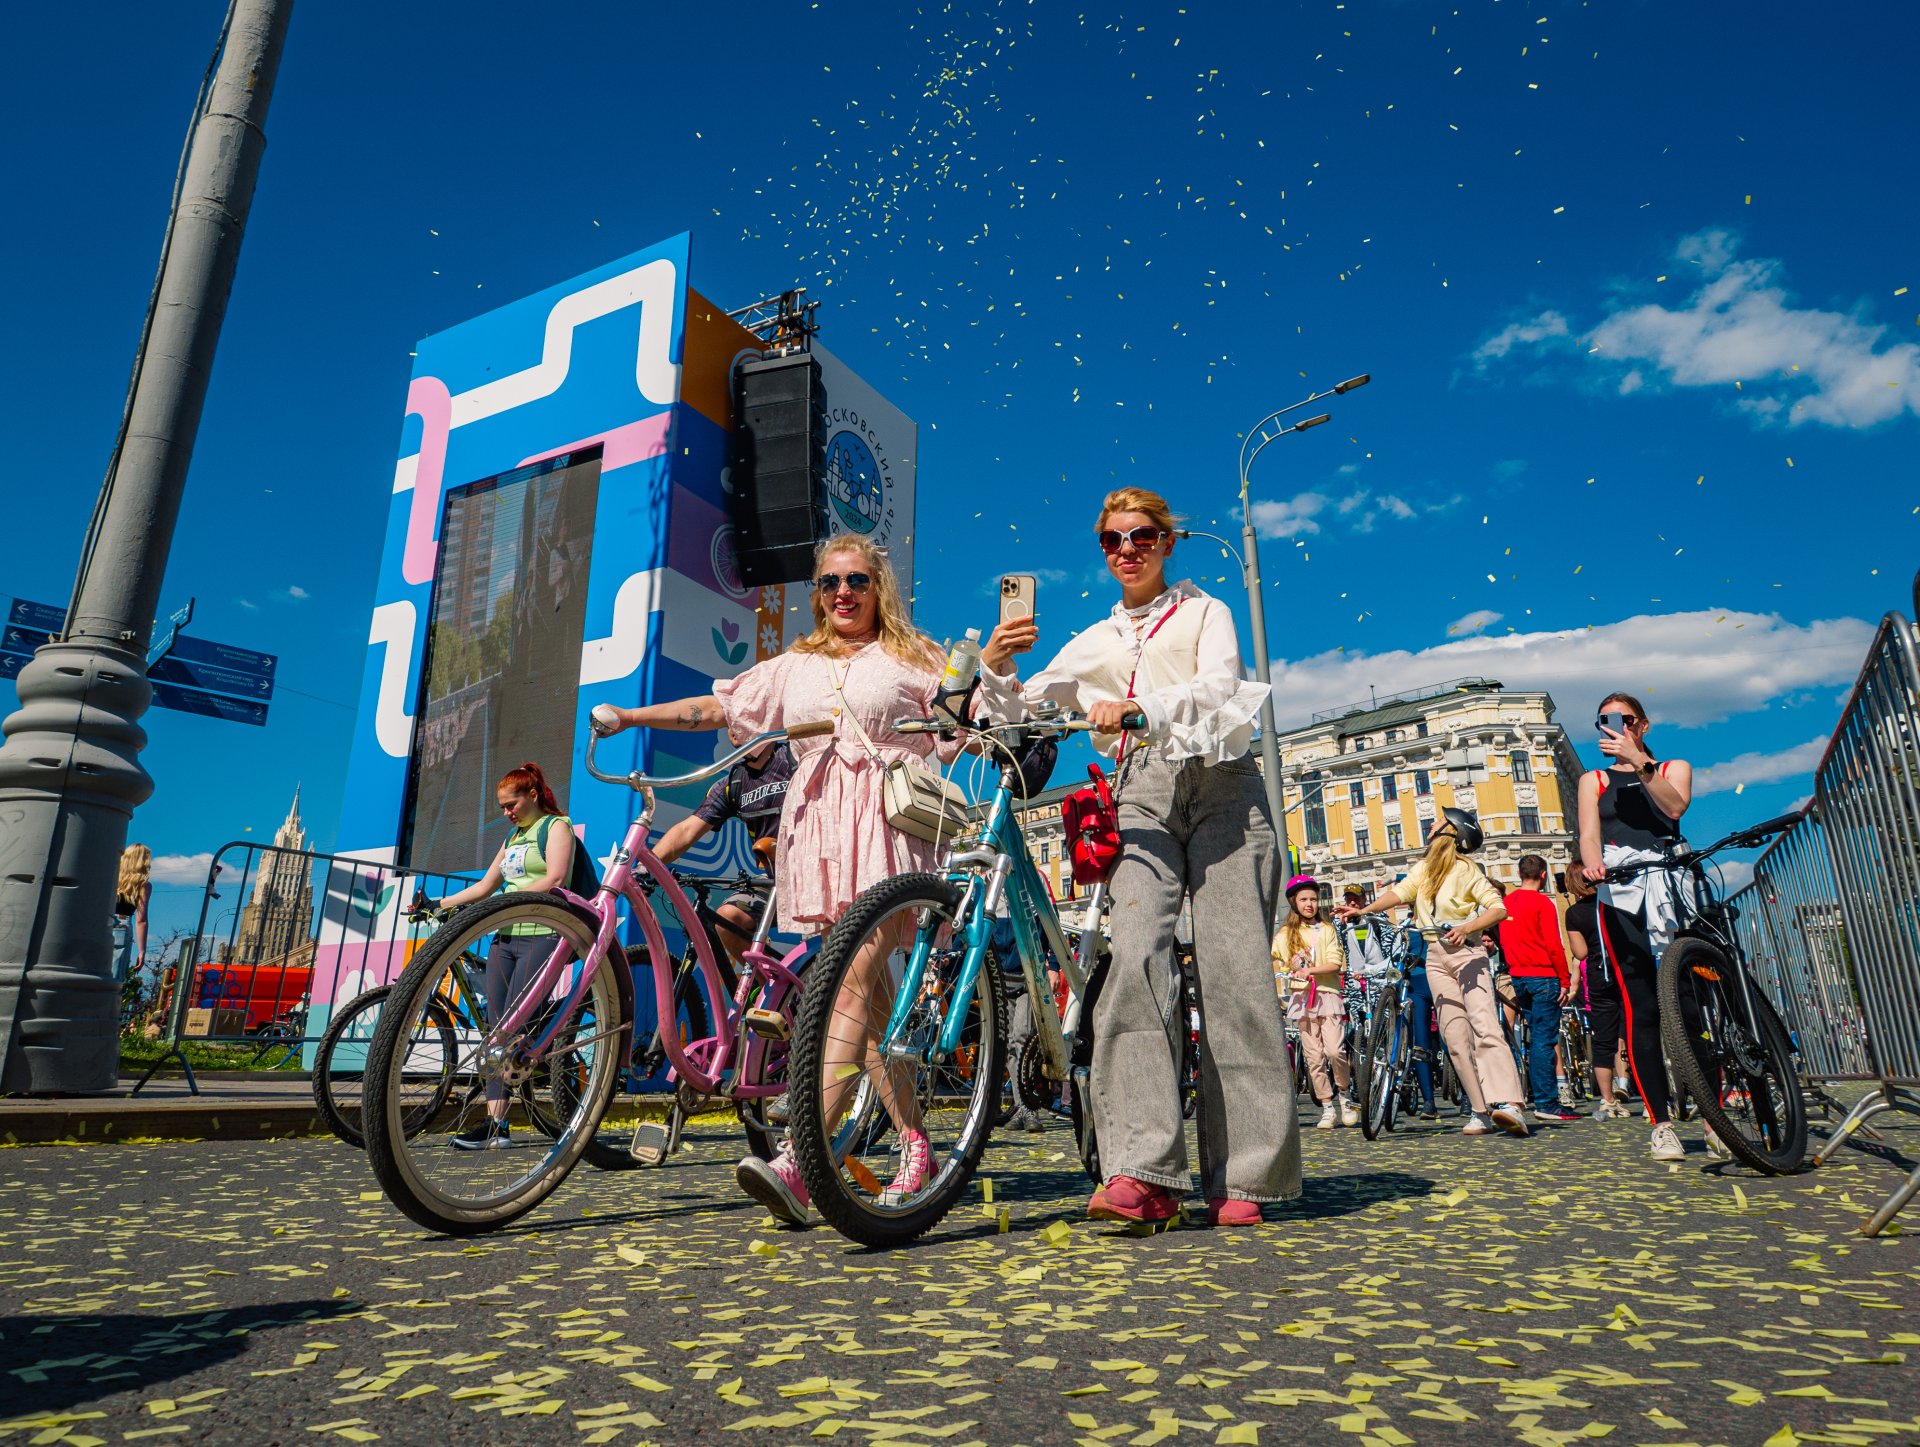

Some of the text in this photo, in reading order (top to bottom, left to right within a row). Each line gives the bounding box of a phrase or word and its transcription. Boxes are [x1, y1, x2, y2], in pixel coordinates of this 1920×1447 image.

[824, 407, 894, 488] ОСКОВСКИЙ
[845, 509, 862, 527] 2024
[986, 948, 1006, 1041] BONTRAGER
